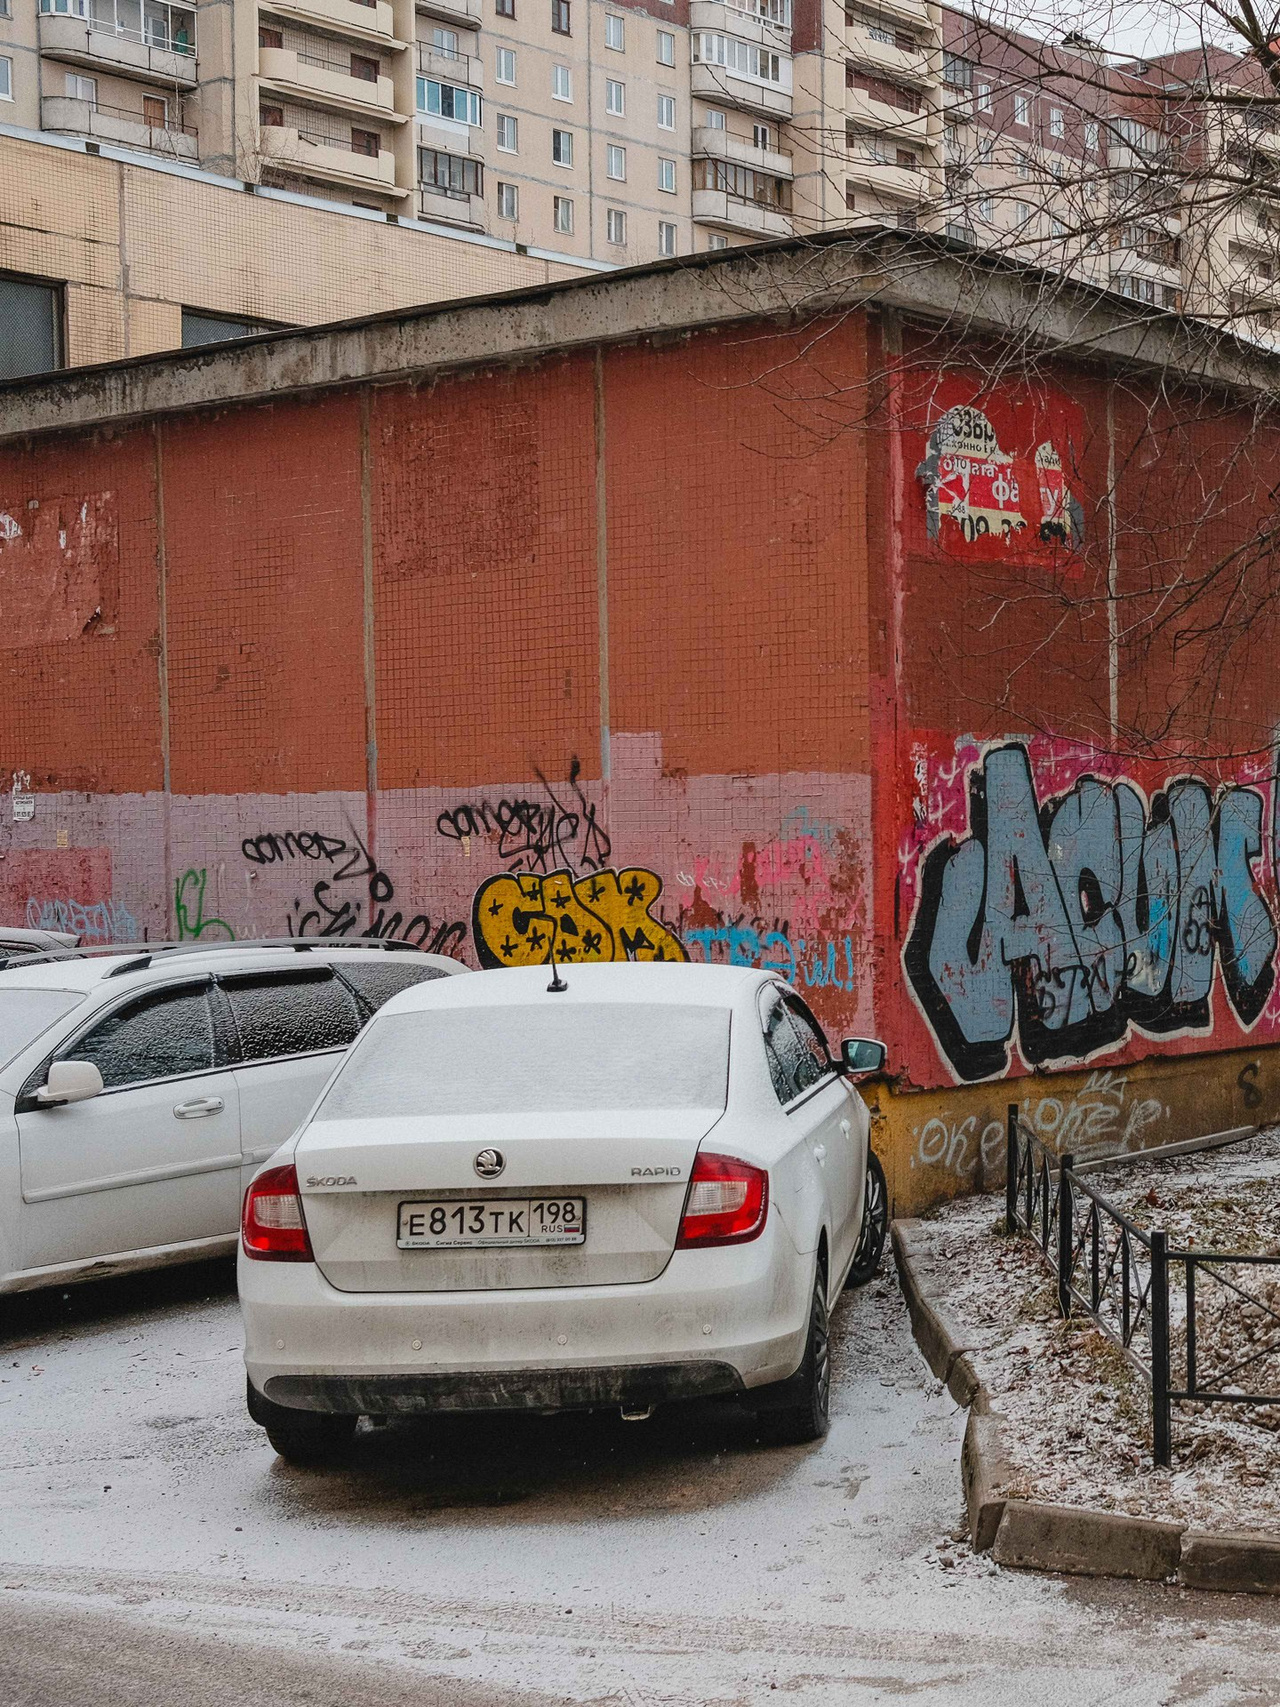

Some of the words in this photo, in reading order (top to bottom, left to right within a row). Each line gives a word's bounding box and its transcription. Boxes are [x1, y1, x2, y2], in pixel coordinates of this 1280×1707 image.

[631, 1166, 681, 1177] RAPID
[306, 1175, 358, 1188] ŠKODA
[533, 1201, 576, 1224] 198
[541, 1224, 563, 1234] RUS
